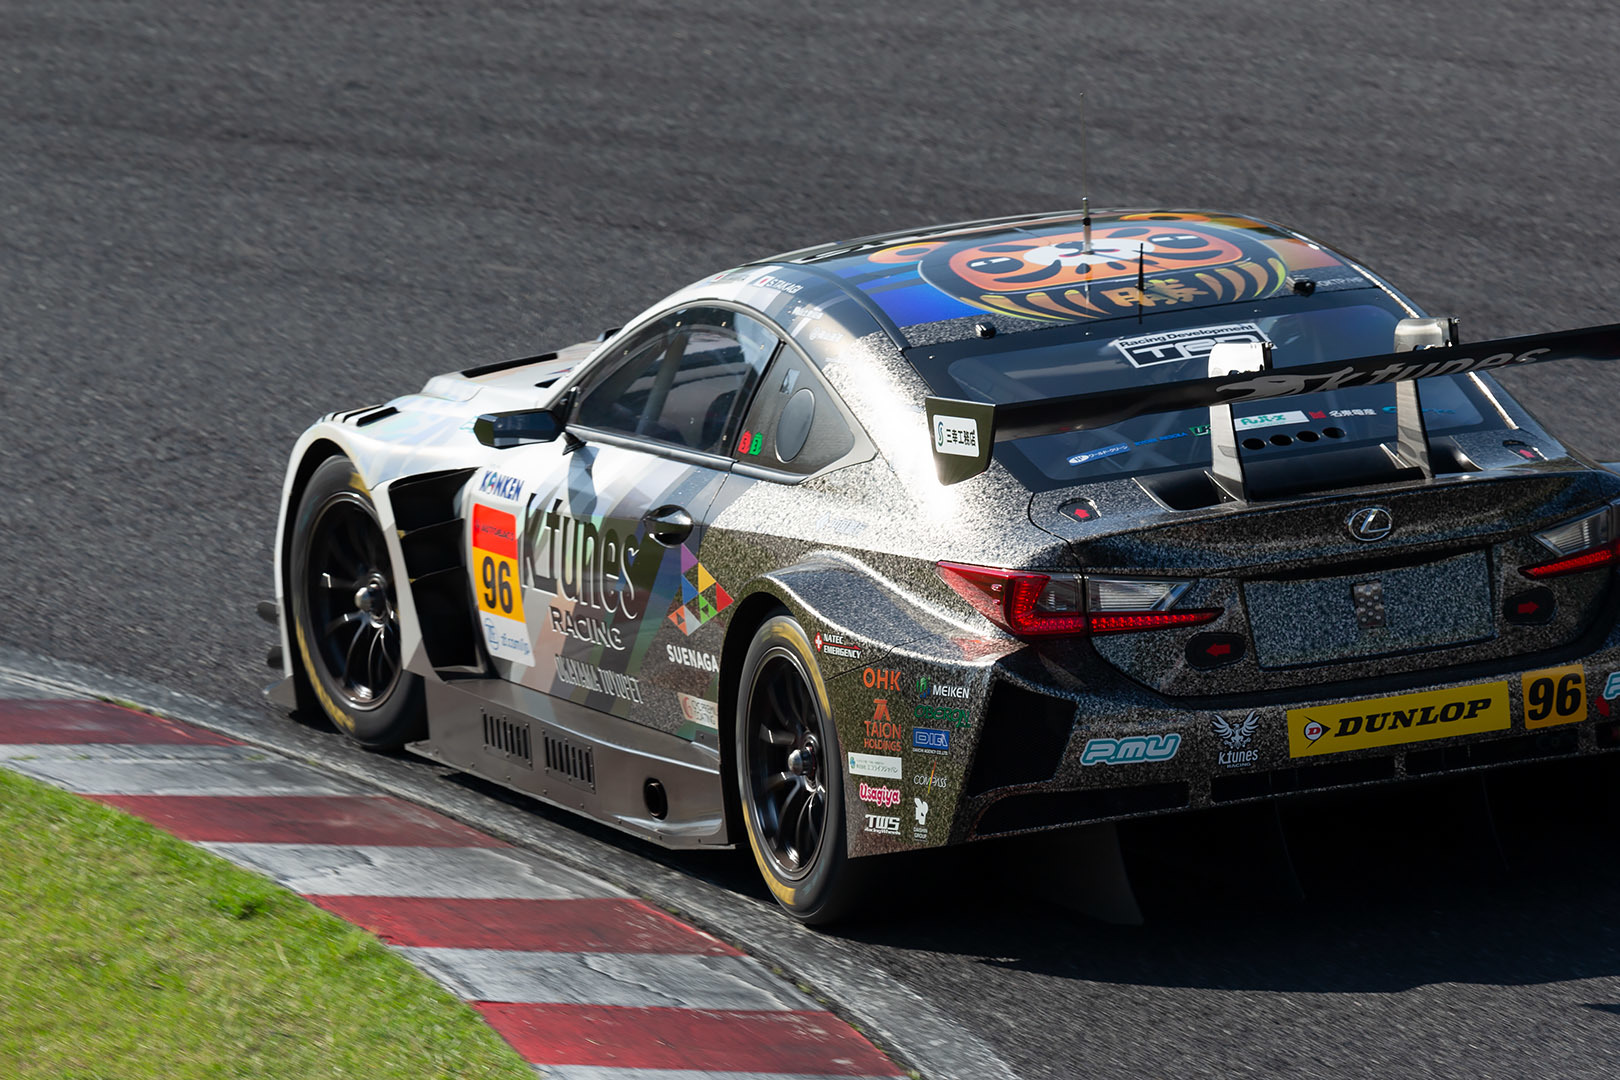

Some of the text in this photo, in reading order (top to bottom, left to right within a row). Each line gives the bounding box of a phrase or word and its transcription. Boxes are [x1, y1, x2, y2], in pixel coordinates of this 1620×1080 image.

[1120, 324, 1255, 349] Racing Development
[482, 555, 513, 615] 96
[548, 604, 626, 652] RACING
[823, 633, 844, 646] NATEC
[666, 644, 719, 673] SUENAGA
[823, 645, 862, 660] EMERGENCY
[597, 667, 645, 705] TOYOPET
[932, 684, 970, 700] MEIKEN
[1526, 672, 1583, 722] 96
[914, 704, 970, 728] OBERON
[1333, 697, 1493, 738] DUNLOP
[864, 720, 902, 740] TAION
[864, 737, 902, 752] HOLDINGS
[914, 775, 948, 788] COMPASS
[859, 782, 901, 808] Usagiya
[864, 814, 901, 830] TWS
